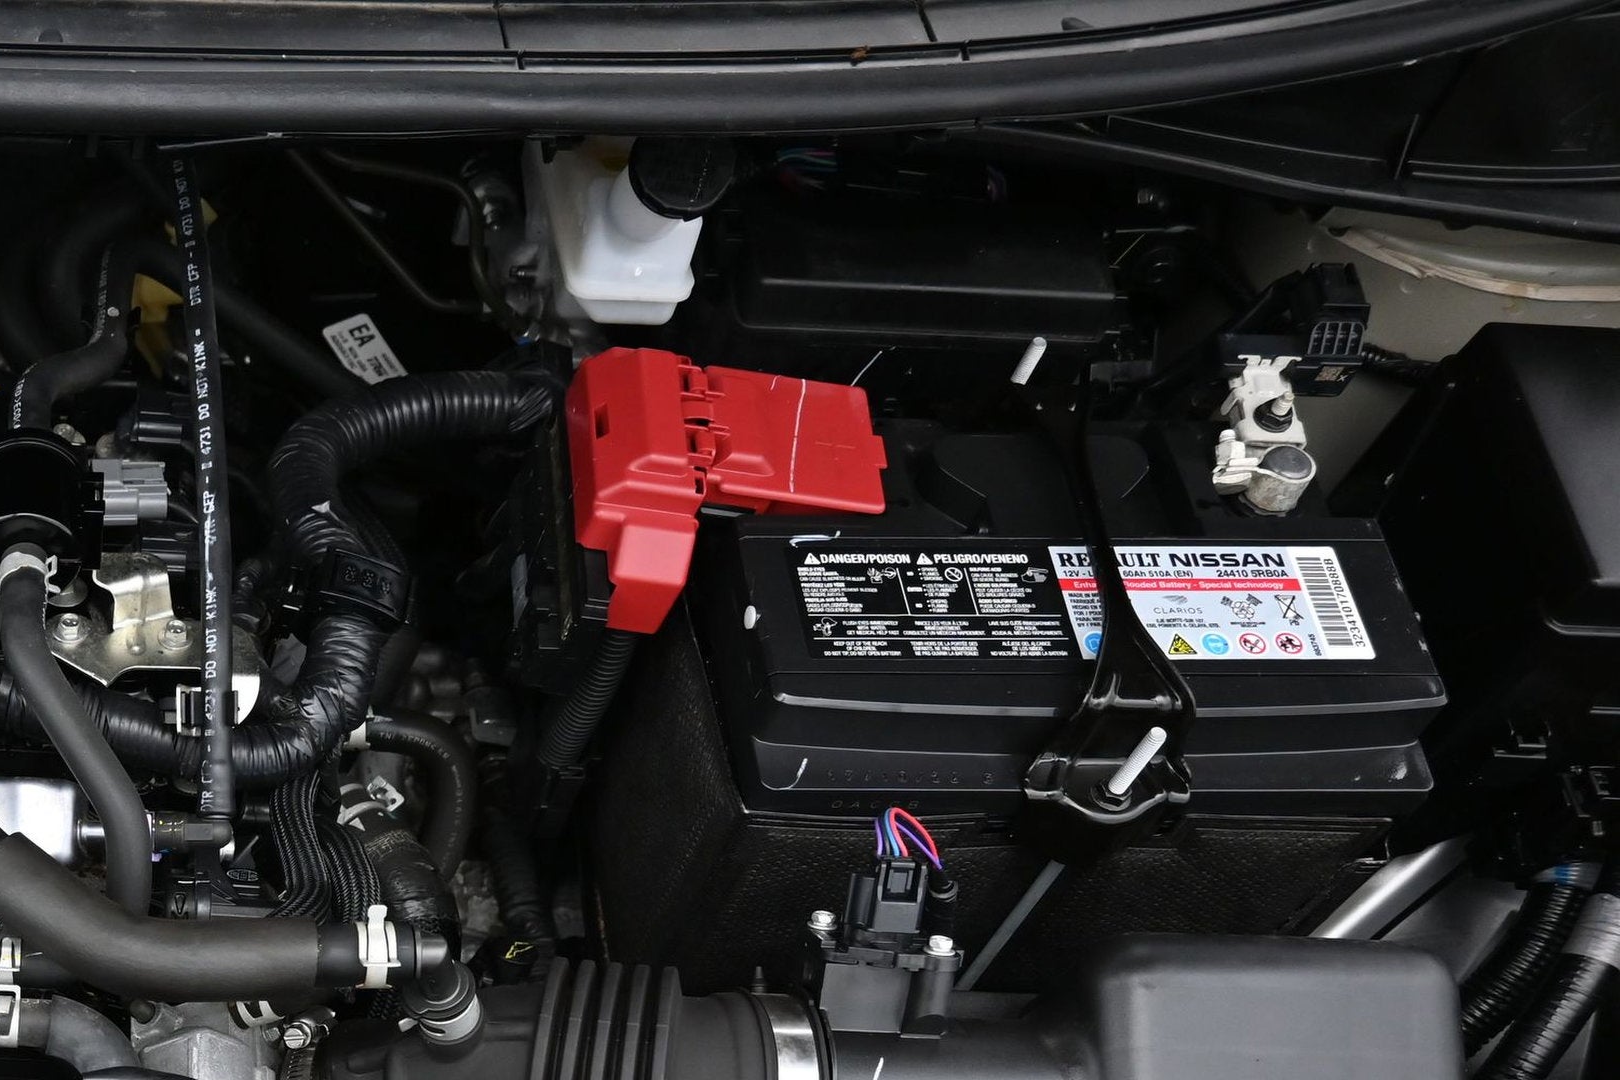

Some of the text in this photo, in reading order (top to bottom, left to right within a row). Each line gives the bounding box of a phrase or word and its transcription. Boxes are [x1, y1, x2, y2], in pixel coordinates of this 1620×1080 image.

[348, 323, 376, 348] EA
[820, 554, 911, 564] DANGER/POISON
[933, 553, 1029, 564] PELIGRO/VENENO
[1170, 553, 1285, 567] NISSAN
[1063, 570, 1079, 578] 12V
[1123, 570, 1147, 578] 60Ah
[1148, 570, 1171, 578] 510A
[1173, 569, 1194, 579] (EN)
[1216, 569, 1249, 578] 24410
[1159, 581, 1191, 590] Battery
[1199, 581, 1231, 590] Special
[1234, 581, 1284, 590] technology
[1153, 607, 1203, 615] CLARIOS
